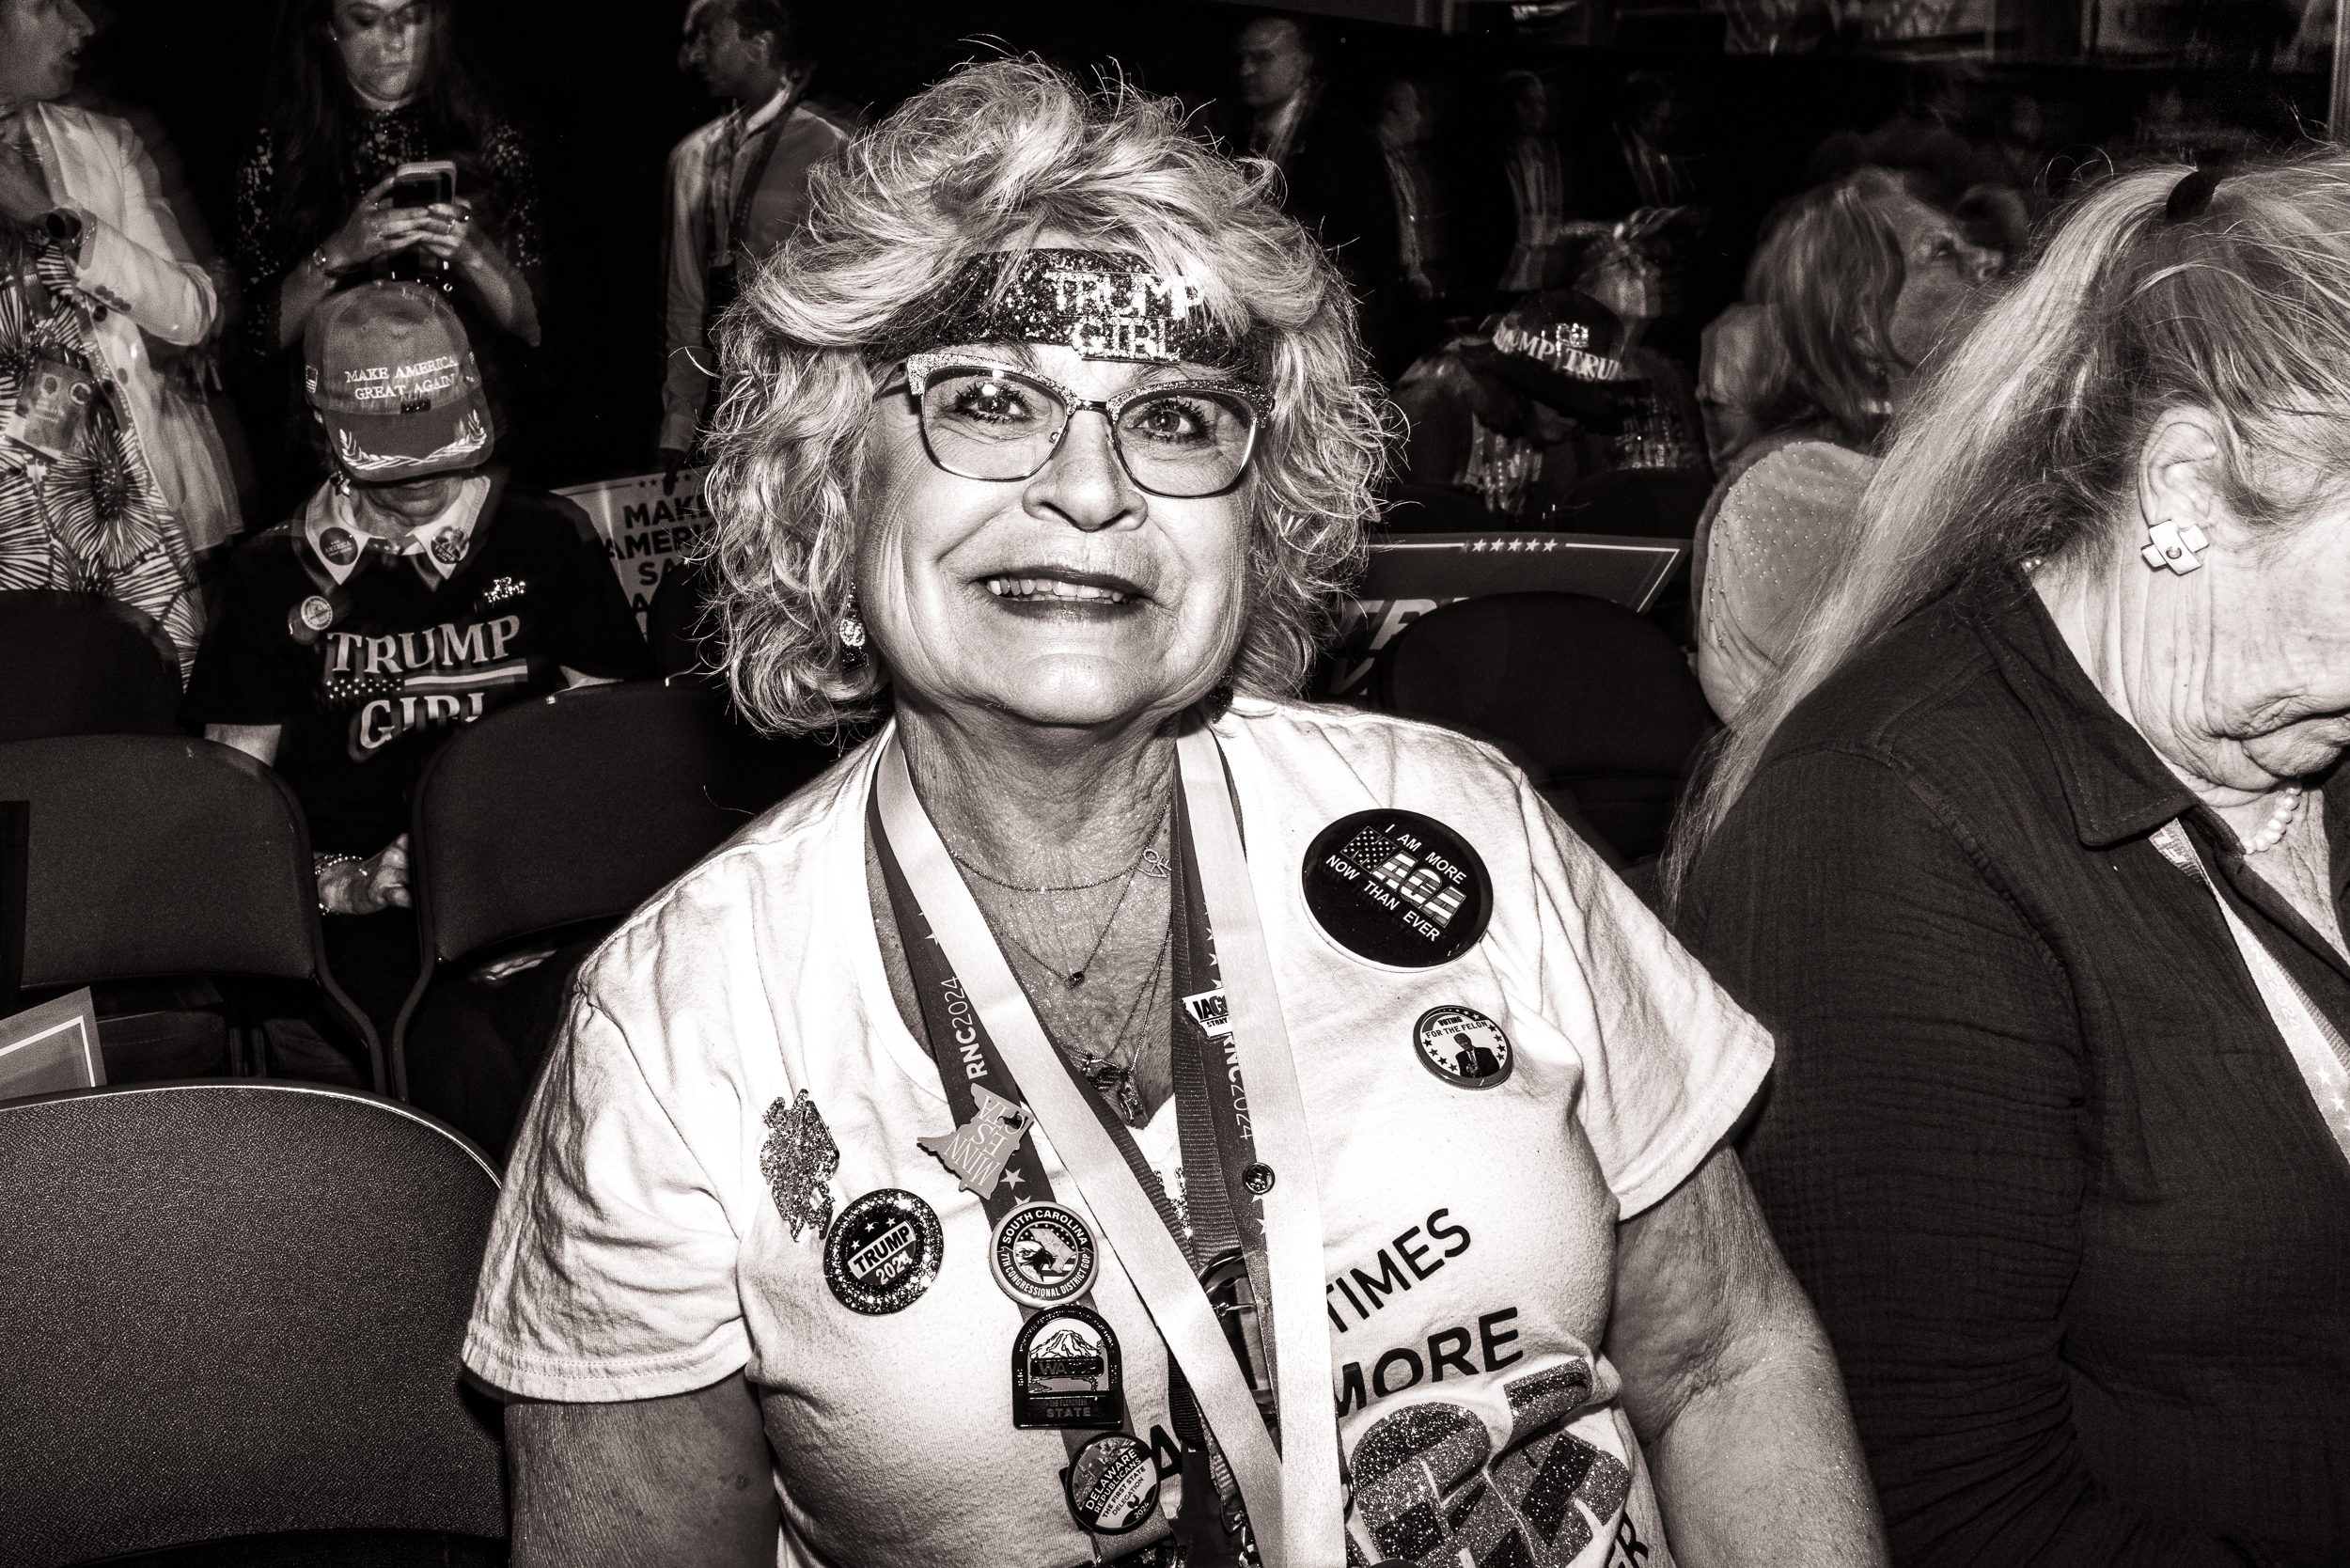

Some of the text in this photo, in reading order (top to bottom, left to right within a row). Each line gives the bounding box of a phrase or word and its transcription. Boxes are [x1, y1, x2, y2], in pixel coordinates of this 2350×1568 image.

[1043, 270, 1205, 321] TRUMP
[1071, 315, 1182, 363] GIRL
[344, 355, 459, 384] MAKE AMERICA
[354, 373, 456, 400] GREAT AGAIN
[604, 520, 716, 561] AMERI
[327, 615, 521, 675] TRUMP
[1385, 823, 1467, 885] I AM MORE
[1325, 855, 1441, 942] NOW THAN EVER
[940, 976, 988, 1080] RNC2024
[1192, 995, 1228, 1021] IAG
[1425, 1021, 1488, 1039] FOR THE FELON
[1437, 1016, 1463, 1027] VOTING
[943, 1133, 1002, 1186] MINN
[852, 1224, 912, 1275] TRUMP
[1002, 1210, 1089, 1246] SOUTH CAROLINA
[1001, 1252, 1091, 1298] 7TH CONGRESSIONAL DISTRICT GOP
[1046, 1407, 1091, 1419] STATE
[1085, 1449, 1137, 1511] DELAWARE
[1093, 1457, 1141, 1513] REPUBLICANS
[1102, 1466, 1146, 1518] THE FIRST STATE
[1112, 1477, 1145, 1516] DELEGATION
[1134, 1502, 1150, 1519] 2024
